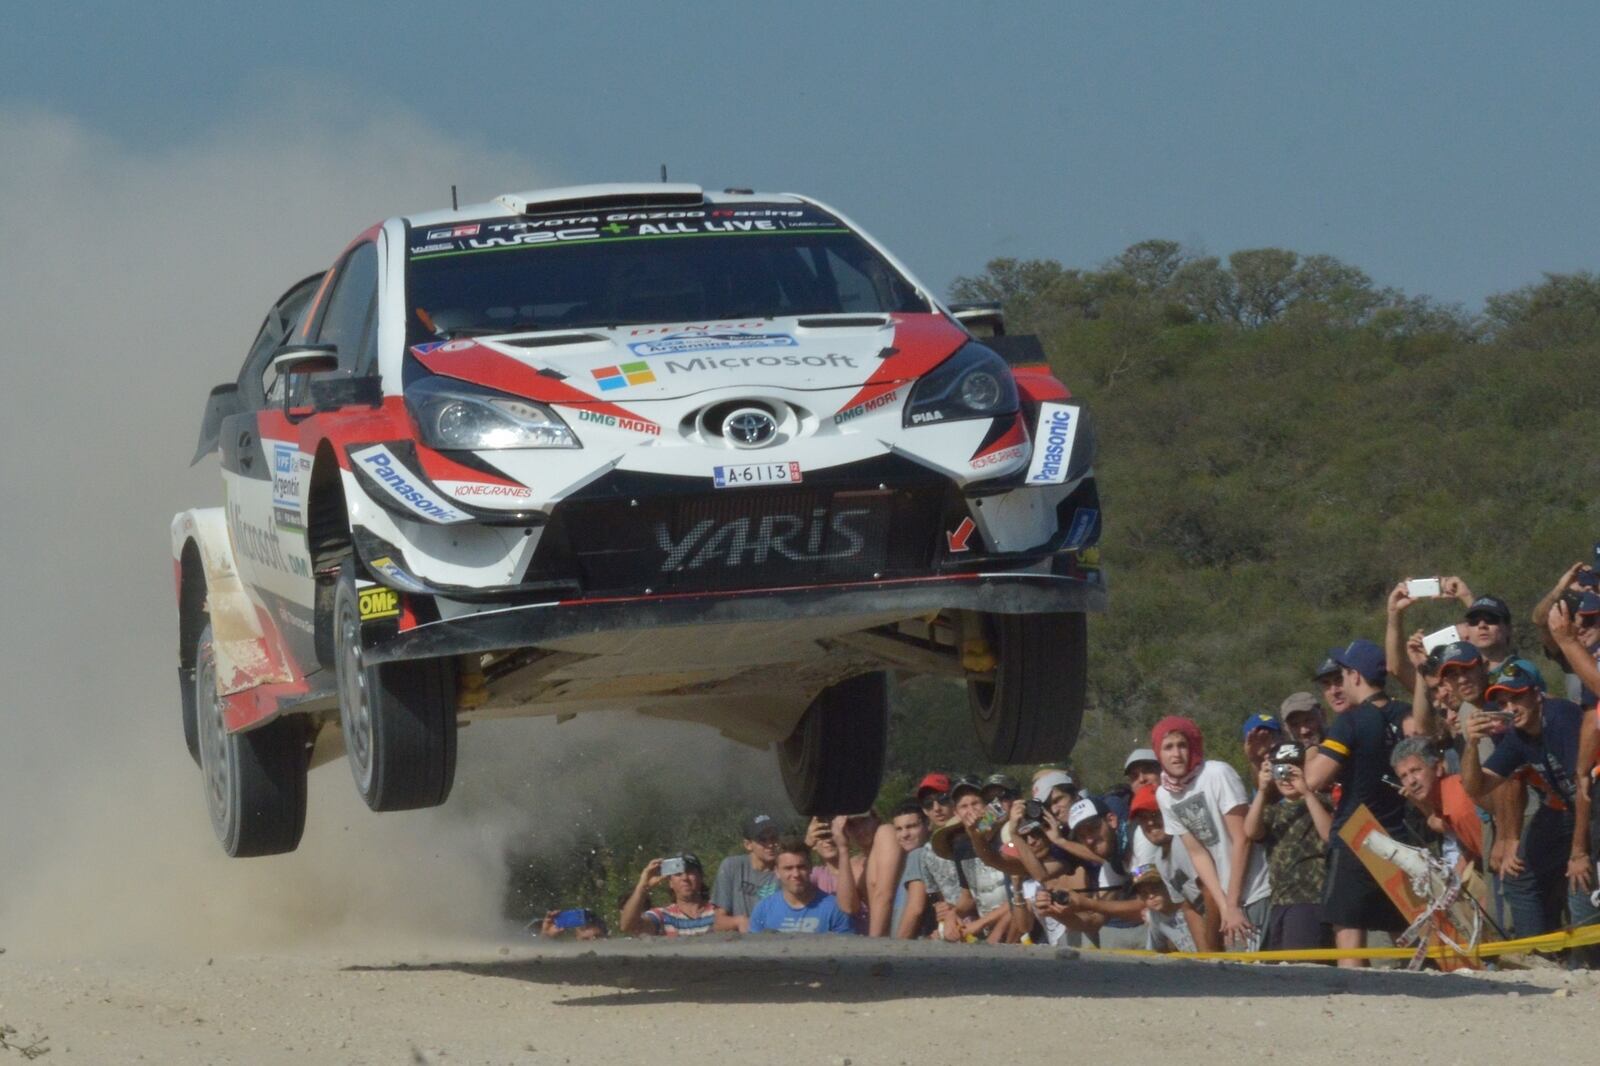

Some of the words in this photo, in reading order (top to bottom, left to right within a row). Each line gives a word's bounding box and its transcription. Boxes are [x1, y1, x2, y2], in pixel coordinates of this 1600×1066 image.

[488, 215, 599, 232] TOYOTA
[606, 210, 706, 222] GAZOO
[711, 209, 803, 219] Racing
[639, 221, 699, 235] ALL
[704, 219, 776, 232] LIVE
[664, 352, 859, 374] Microsoft
[833, 406, 864, 425] DMG
[864, 391, 897, 412] MORI
[911, 410, 944, 424] PIAA
[578, 410, 616, 428] DMG
[618, 418, 662, 437] MORI
[1033, 410, 1071, 482] Panasonic
[364, 452, 458, 523] Panasonic
